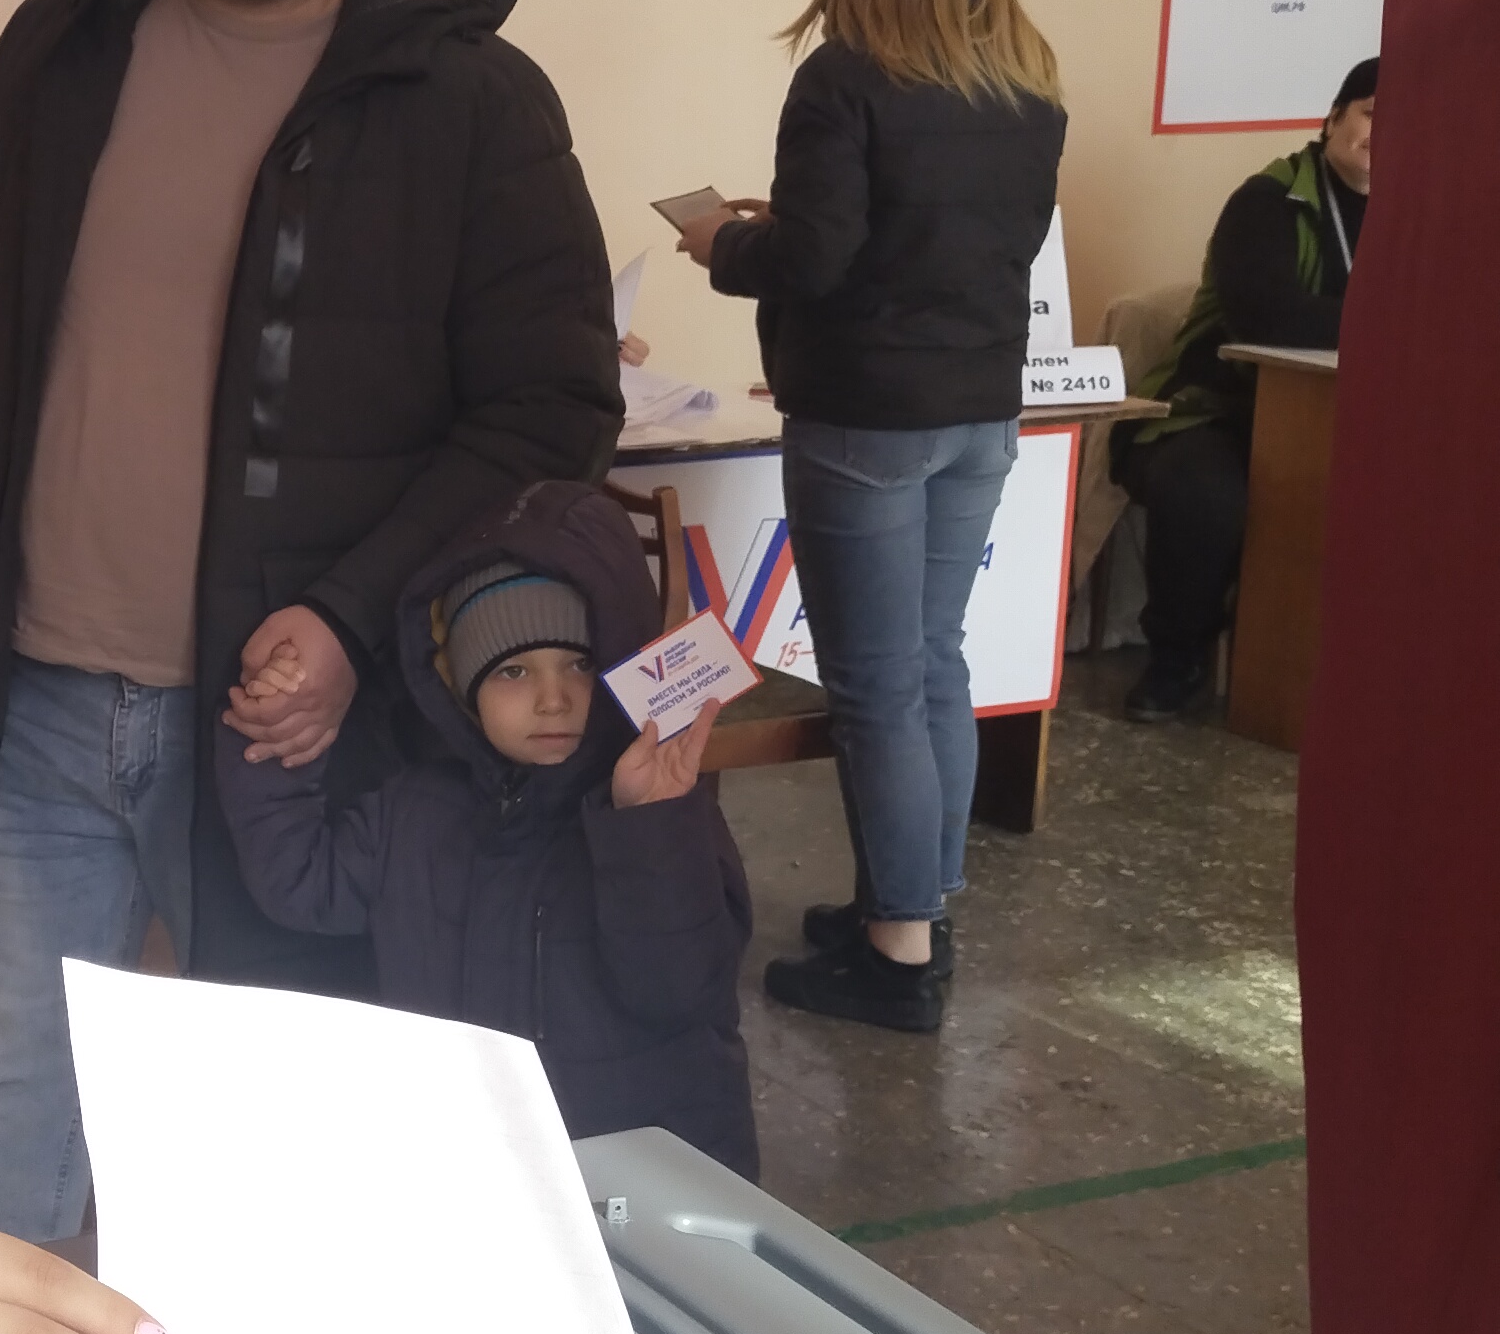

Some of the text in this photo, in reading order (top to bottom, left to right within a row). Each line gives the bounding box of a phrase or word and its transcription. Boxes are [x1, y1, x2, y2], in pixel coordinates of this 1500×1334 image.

[1030, 375, 1111, 393] № 2410
[647, 684, 678, 706] ВМЕСТЕ
[676, 676, 692, 691] МЫ
[691, 664, 712, 680] СИЛА
[647, 692, 687, 720] ГОЛОСУЕМ
[686, 686, 698, 697] ЗА
